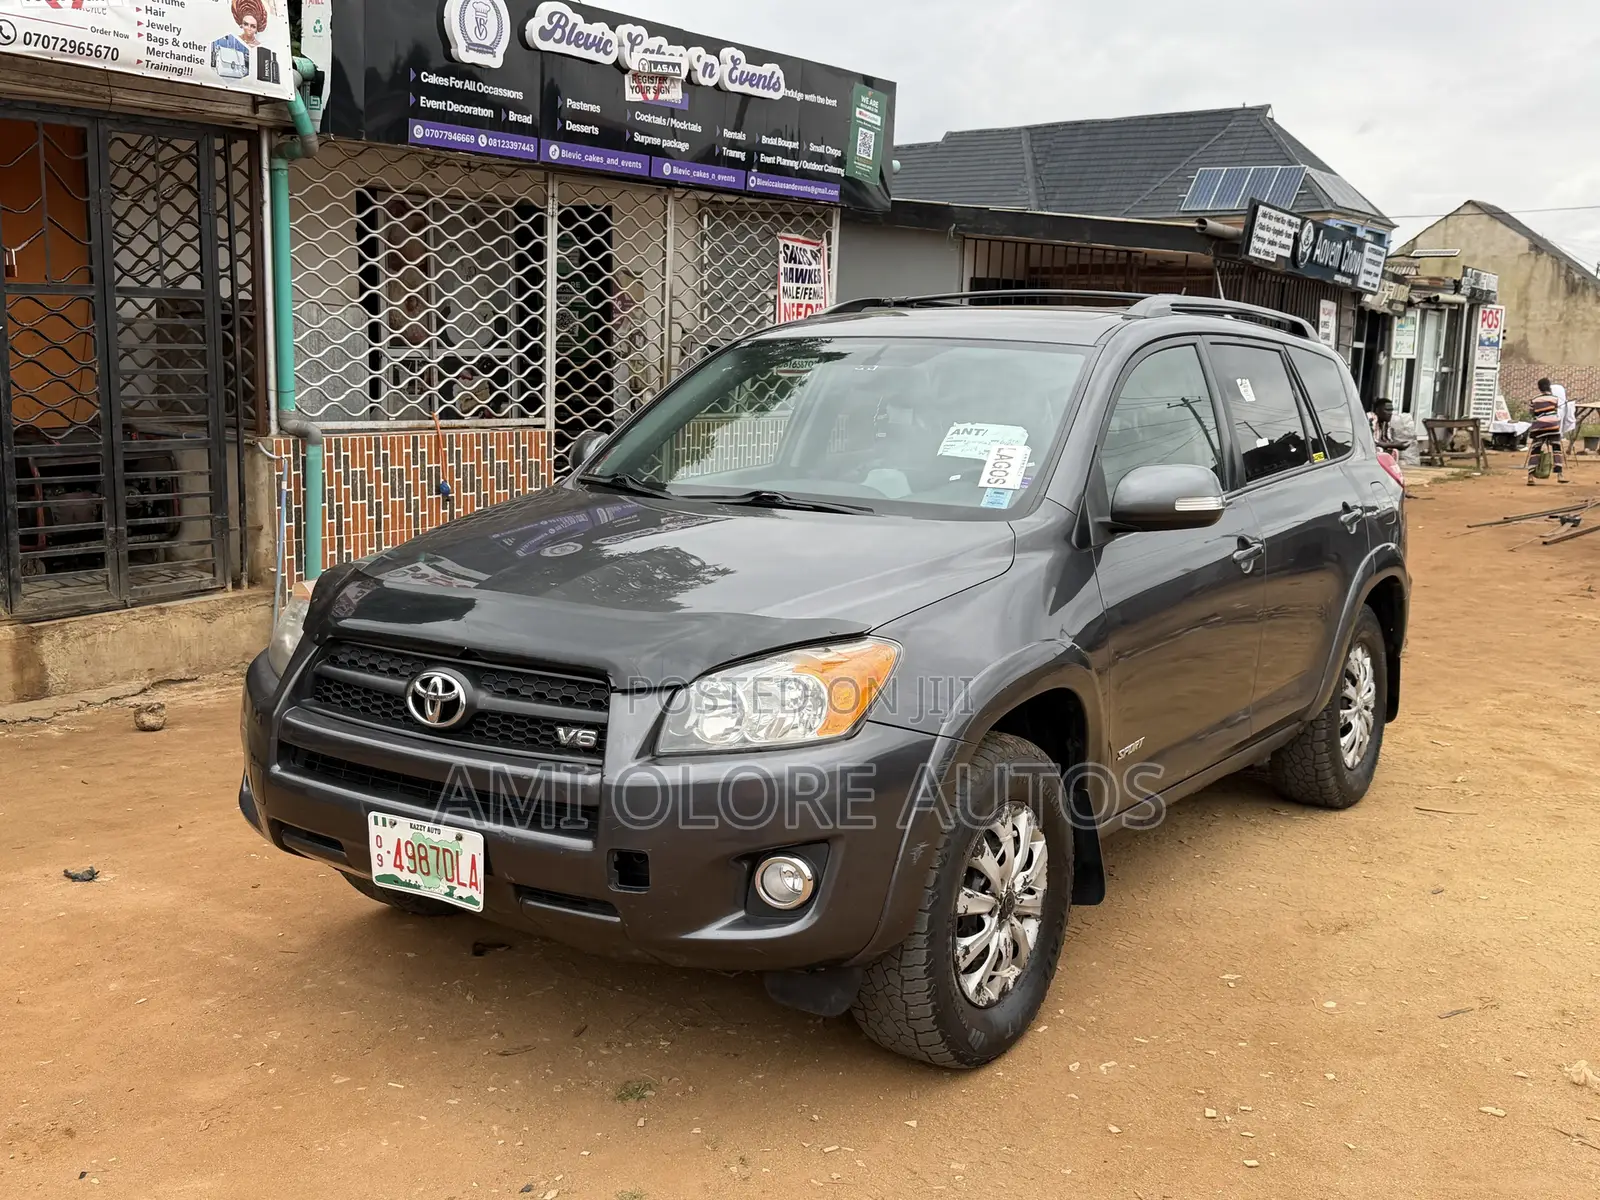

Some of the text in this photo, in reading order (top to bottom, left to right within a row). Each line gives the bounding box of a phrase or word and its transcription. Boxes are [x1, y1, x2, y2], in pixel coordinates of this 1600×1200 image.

[145, 5, 165, 18] Hair
[90, 26, 129, 39] Order Now
[146, 19, 182, 36] Jewelry
[538, 11, 613, 56] Blevic
[23, 31, 119, 61] 07072965670
[146, 32, 207, 53] Bags & other
[146, 46, 205, 66] Merchandise
[145, 59, 193, 77] Training!!!
[651, 63, 681, 74] LASAA
[728, 54, 781, 93] Events
[420, 71, 449, 87] Cakes
[449, 76, 464, 89] For
[463, 80, 476, 92] All
[632, 73, 668, 85] REGISTER
[630, 85, 670, 95] YOUR SIGN
[420, 96, 494, 118] Event Decoration
[508, 111, 532, 124] Bread
[634, 111, 666, 126] Cocktails
[670, 118, 702, 133] Mocktails
[565, 120, 599, 135] Desserts
[723, 128, 746, 141] Rentals
[661, 138, 689, 152] package
[722, 147, 746, 161] Training
[760, 153, 776, 164] Event
[1481, 309, 1500, 329] POS
[986, 447, 1017, 485] LAGOS
[556, 726, 598, 748] V6
[426, 824, 442, 836] AUTO
